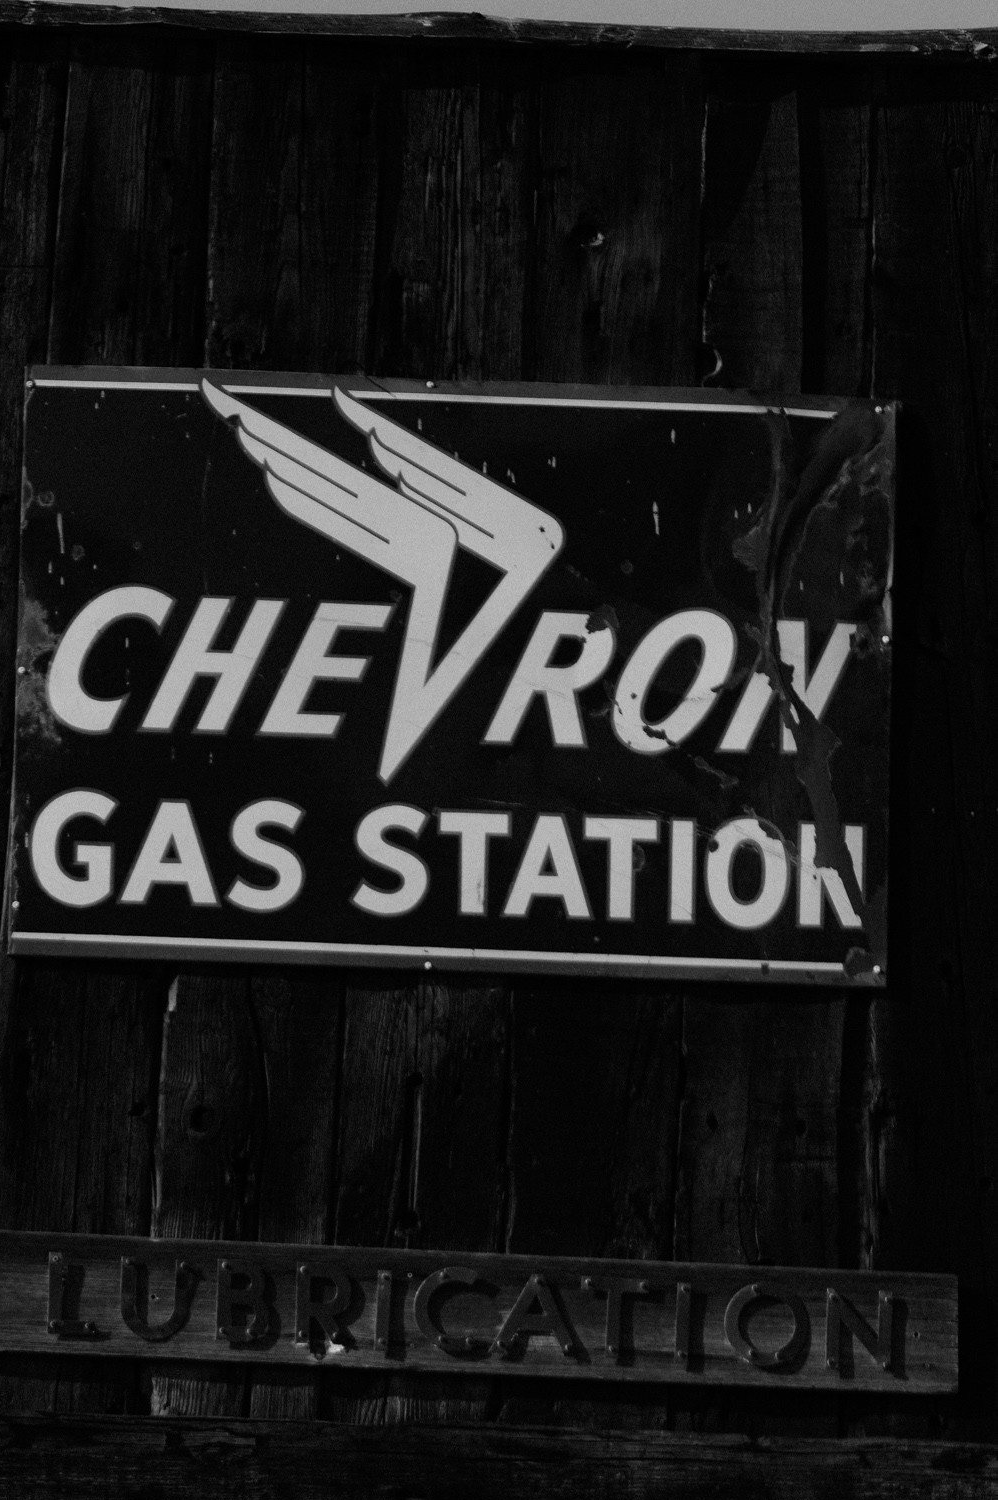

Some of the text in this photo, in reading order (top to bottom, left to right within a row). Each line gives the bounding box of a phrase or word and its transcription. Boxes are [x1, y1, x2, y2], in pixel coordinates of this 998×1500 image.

[46, 525, 859, 786] CHEVRON
[29, 787, 866, 930] GAS STATION
[47, 1251, 895, 1372] LUBRICATION
